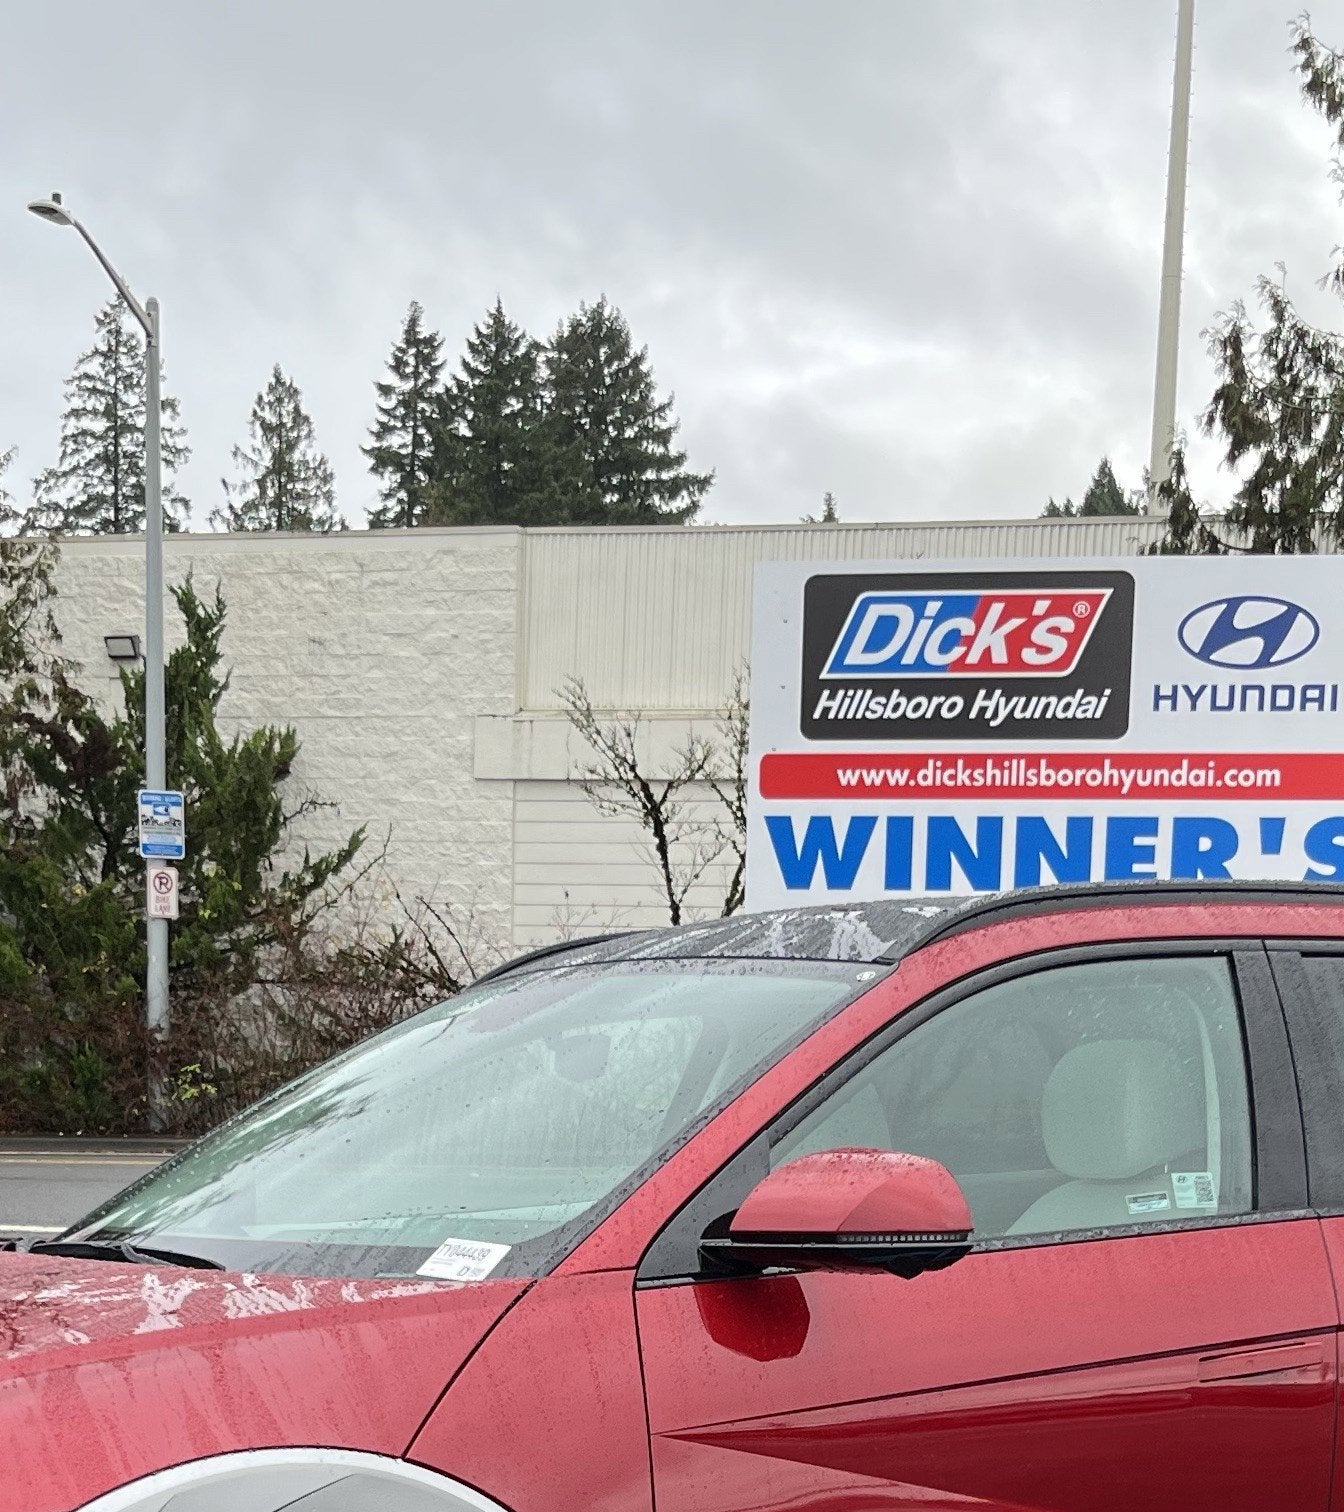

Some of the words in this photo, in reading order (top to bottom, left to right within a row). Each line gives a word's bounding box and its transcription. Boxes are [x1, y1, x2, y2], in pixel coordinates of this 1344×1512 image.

[843, 599, 1075, 666] Dick's
[812, 688, 963, 720] Hillsboro
[969, 688, 1112, 727] Hyundai
[1153, 684, 1338, 713] HYUNDAI
[836, 758, 1281, 795] www.dickshillsborohyundai.com
